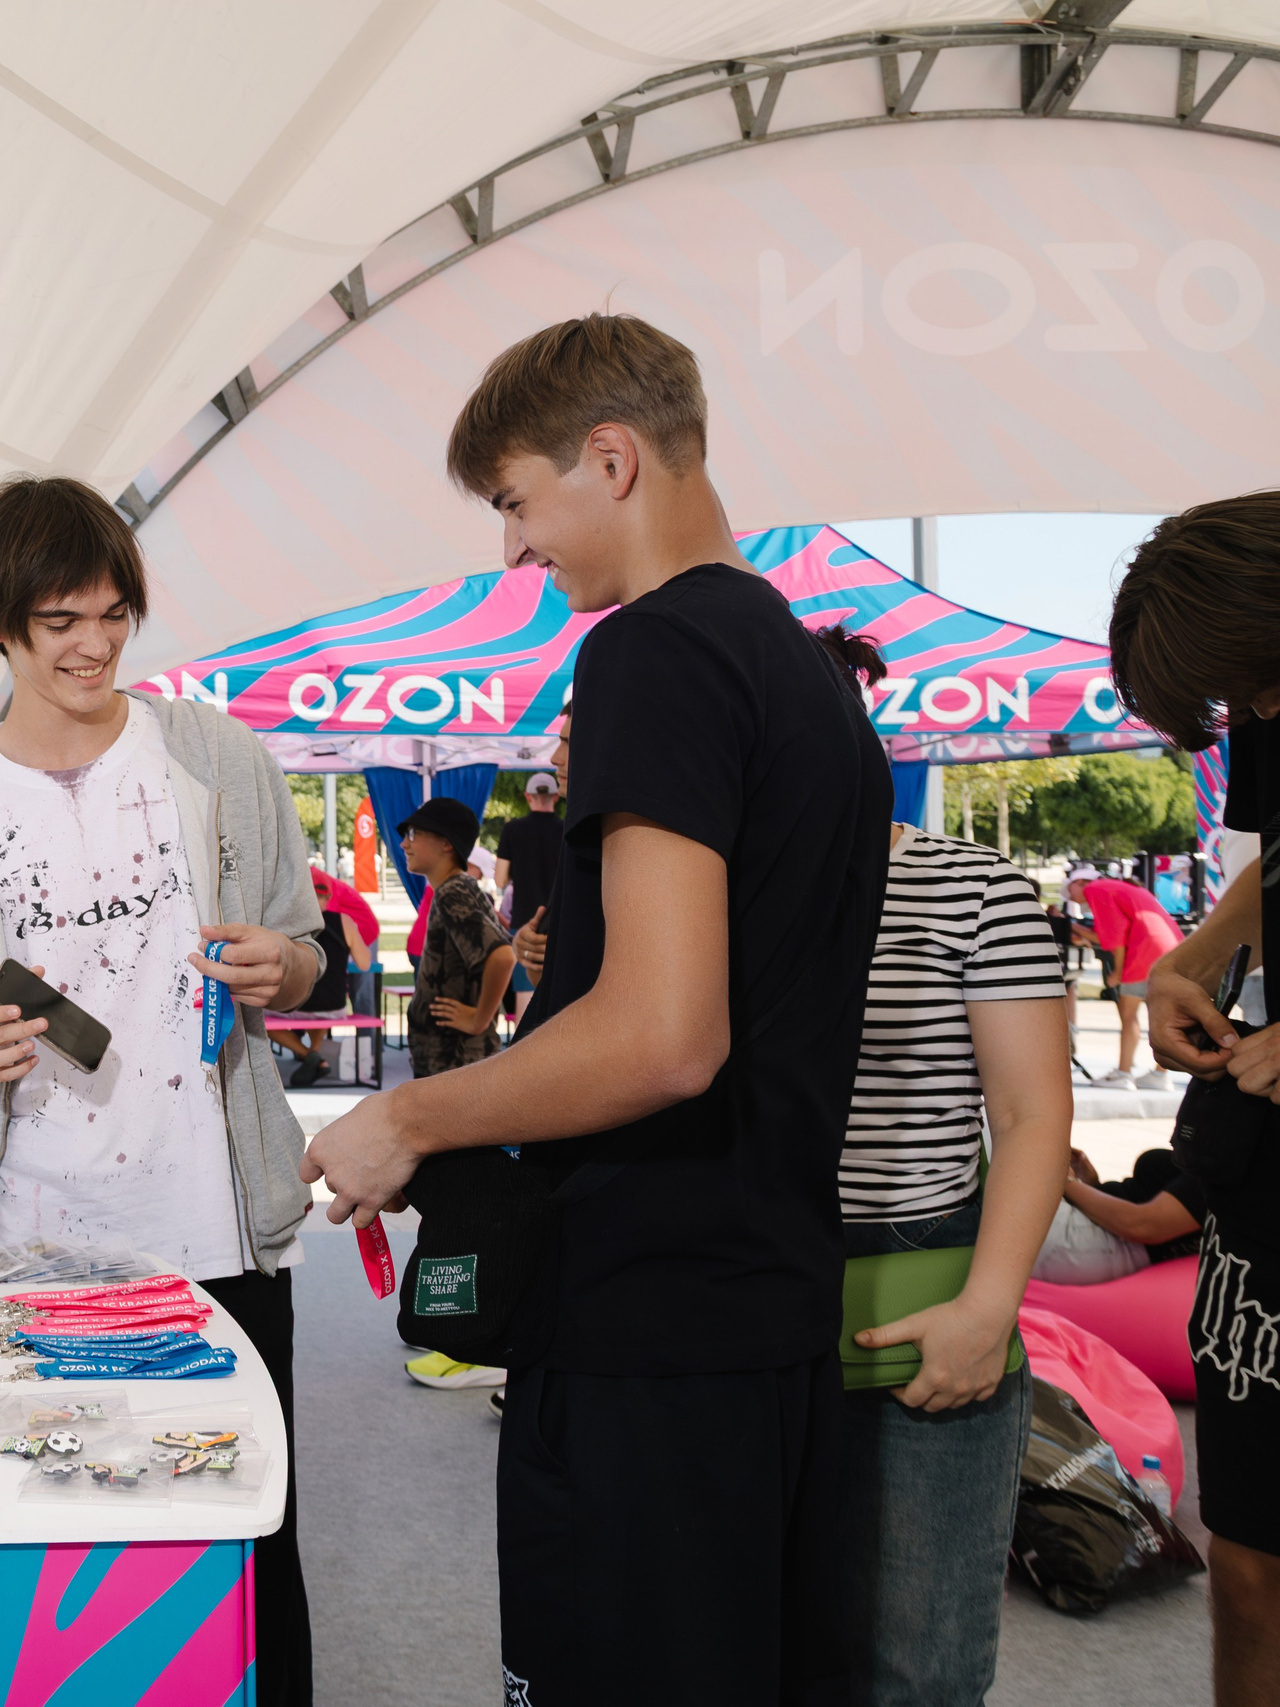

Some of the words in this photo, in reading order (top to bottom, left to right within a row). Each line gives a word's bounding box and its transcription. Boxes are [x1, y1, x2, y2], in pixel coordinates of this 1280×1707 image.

[288, 672, 505, 725] OZON
[862, 676, 1030, 724] ZON
[209, 994, 217, 1007] FC
[209, 1008, 216, 1016] X
[208, 1018, 216, 1046] OZON
[375, 1240, 385, 1255] FC
[381, 1255, 388, 1265] X
[431, 1265, 463, 1275] LIVING
[383, 1265, 392, 1293] OZON
[422, 1273, 471, 1285] TRAVELING
[90, 1281, 158, 1295] KRASNODAR
[430, 1284, 458, 1295] SHARE
[119, 1293, 190, 1308] KRASNODAR
[117, 1323, 192, 1335] KRASNODAR
[146, 1356, 227, 1377] KRASNODAR
